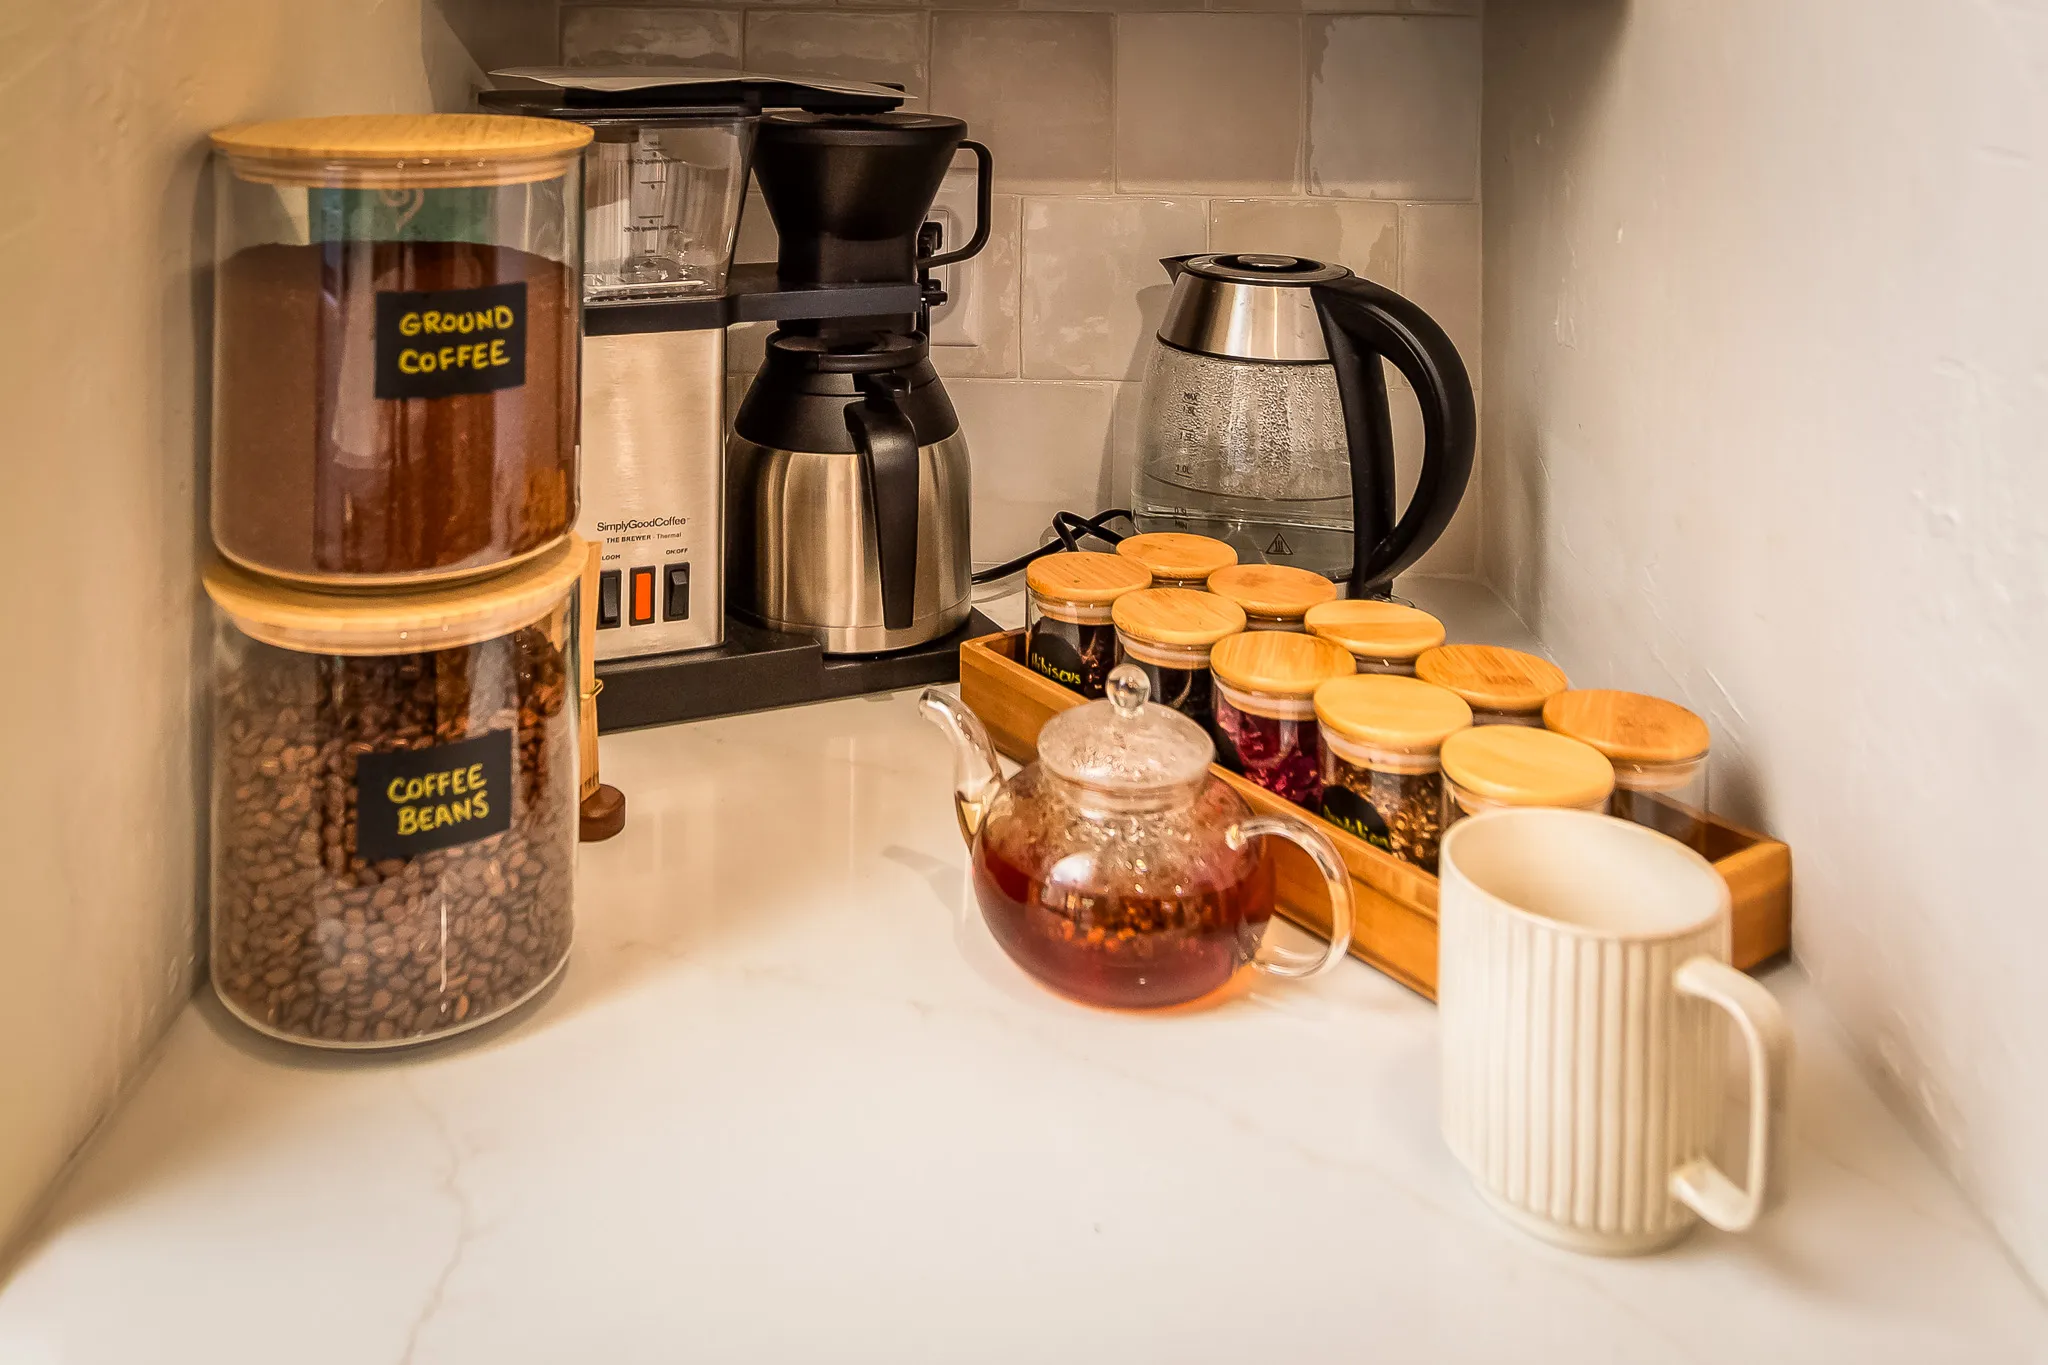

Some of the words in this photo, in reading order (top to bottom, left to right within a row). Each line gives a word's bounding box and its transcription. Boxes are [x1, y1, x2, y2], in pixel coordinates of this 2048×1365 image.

[399, 305, 514, 337] GROUND
[398, 338, 511, 375] COFFEE
[621, 534, 652, 543] BREWER
[656, 532, 682, 540] Thermal
[386, 762, 488, 804] COFFEE
[397, 789, 490, 836] BEANS
